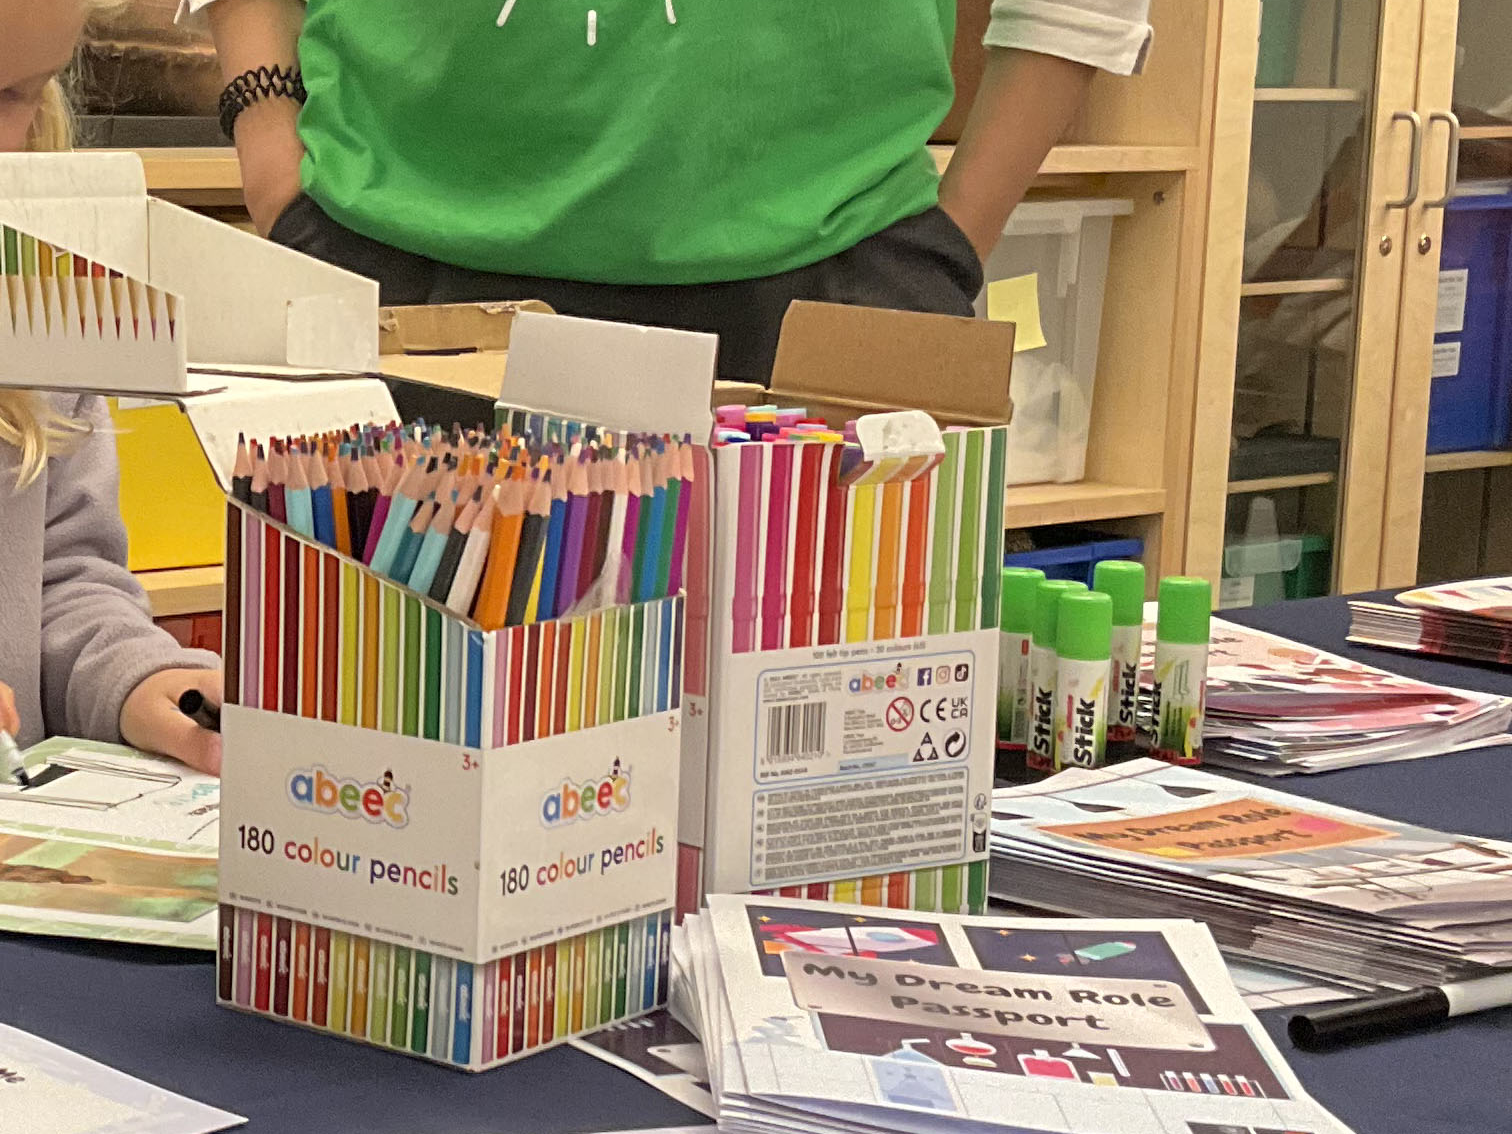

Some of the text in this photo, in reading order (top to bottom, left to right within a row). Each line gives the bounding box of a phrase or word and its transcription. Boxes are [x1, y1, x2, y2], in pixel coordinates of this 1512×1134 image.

[689, 702, 703, 716] 3+
[951, 697, 969, 708] UK
[951, 708, 969, 719] CA
[1118, 663, 1137, 726] Stick
[667, 716, 680, 732] 3+
[1033, 687, 1053, 755] Stick
[1073, 698, 1096, 766] Stick
[462, 753, 480, 771] 3+
[290, 770, 405, 823] abeec
[543, 775, 629, 822] abeec
[1124, 819, 1230, 838] Dream
[1217, 807, 1292, 823] Role
[1175, 828, 1314, 851] Passport
[238, 824, 459, 896] 180 colour pencils
[500, 827, 665, 896] 180 colour pencils
[802, 962, 1176, 1009] My Dream Role
[890, 995, 1110, 1031] Passport
